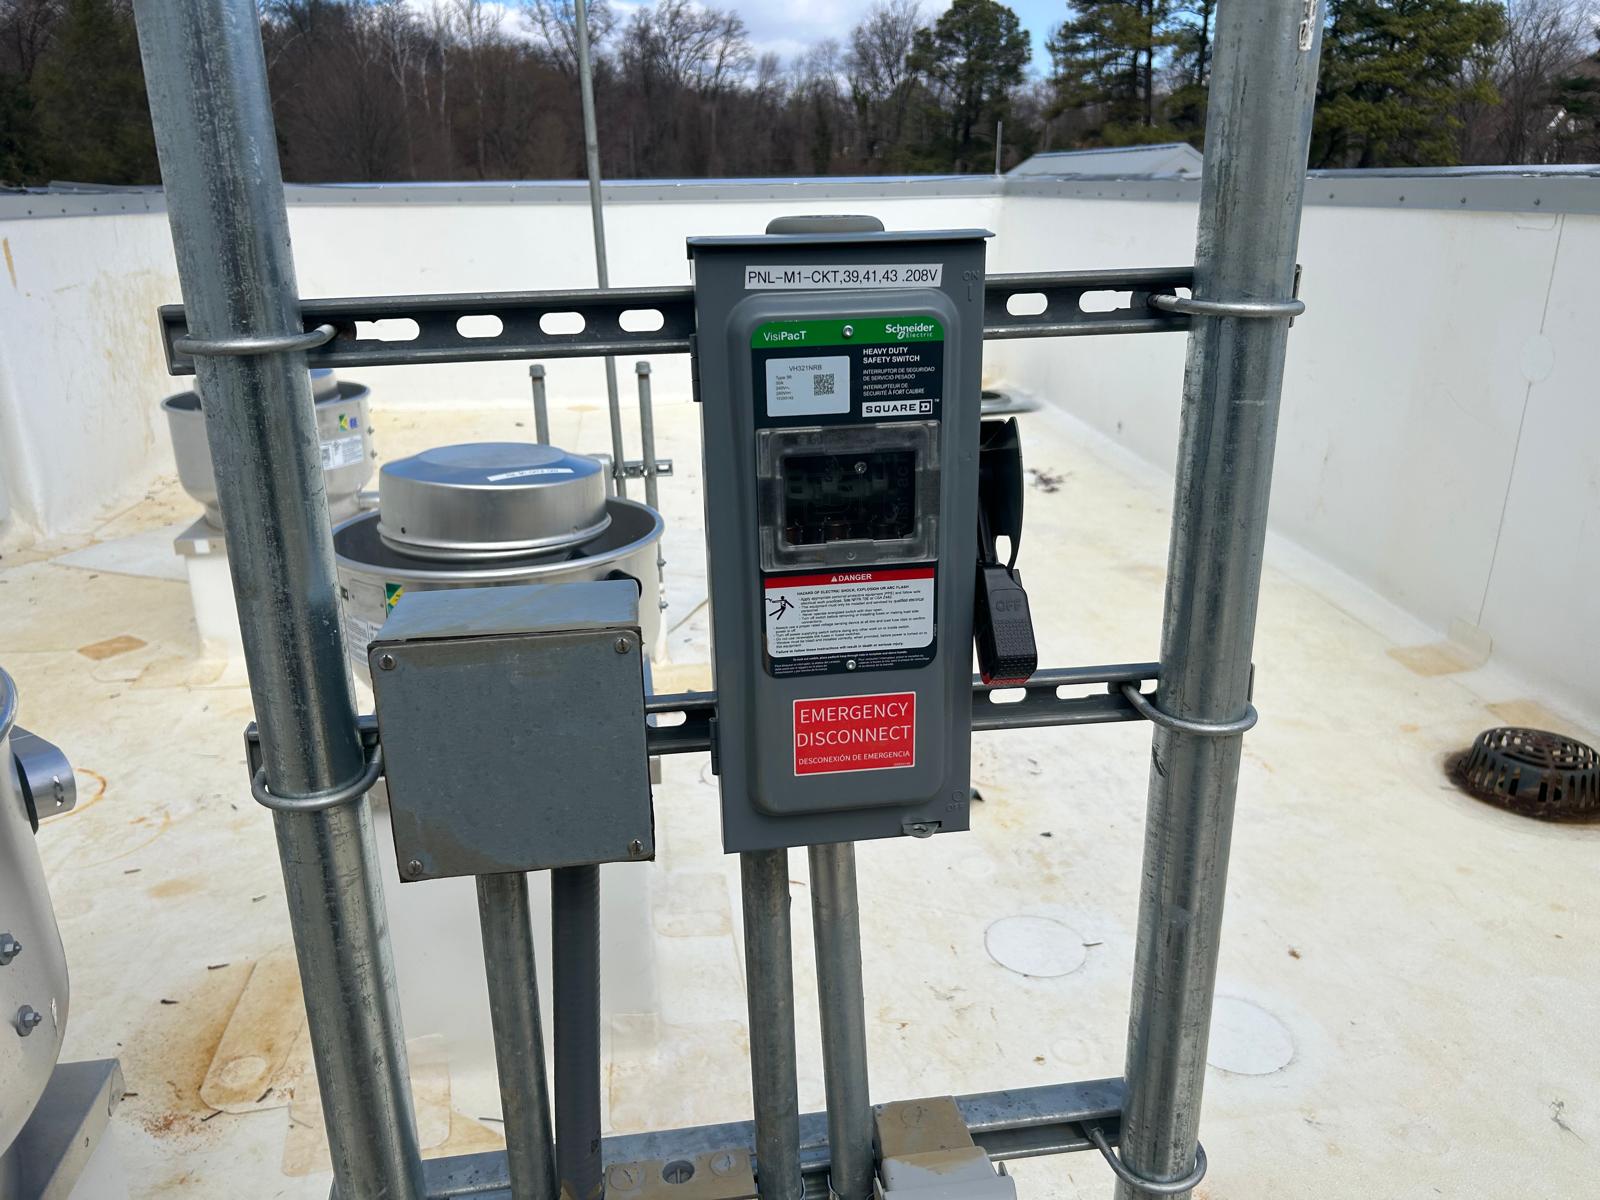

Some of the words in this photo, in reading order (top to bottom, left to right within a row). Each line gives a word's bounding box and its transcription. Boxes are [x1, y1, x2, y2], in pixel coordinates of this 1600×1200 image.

[885, 323, 934, 334] Schneider
[763, 331, 807, 342] VisiPacT
[866, 403, 917, 414] SQUARE
[838, 574, 872, 582] DANGER
[800, 702, 909, 724] EMERGENCY
[797, 725, 912, 748] DISCONNECT
[798, 754, 851, 766] DESCONEXIÓN
[863, 750, 910, 760] EMERGENCIA
